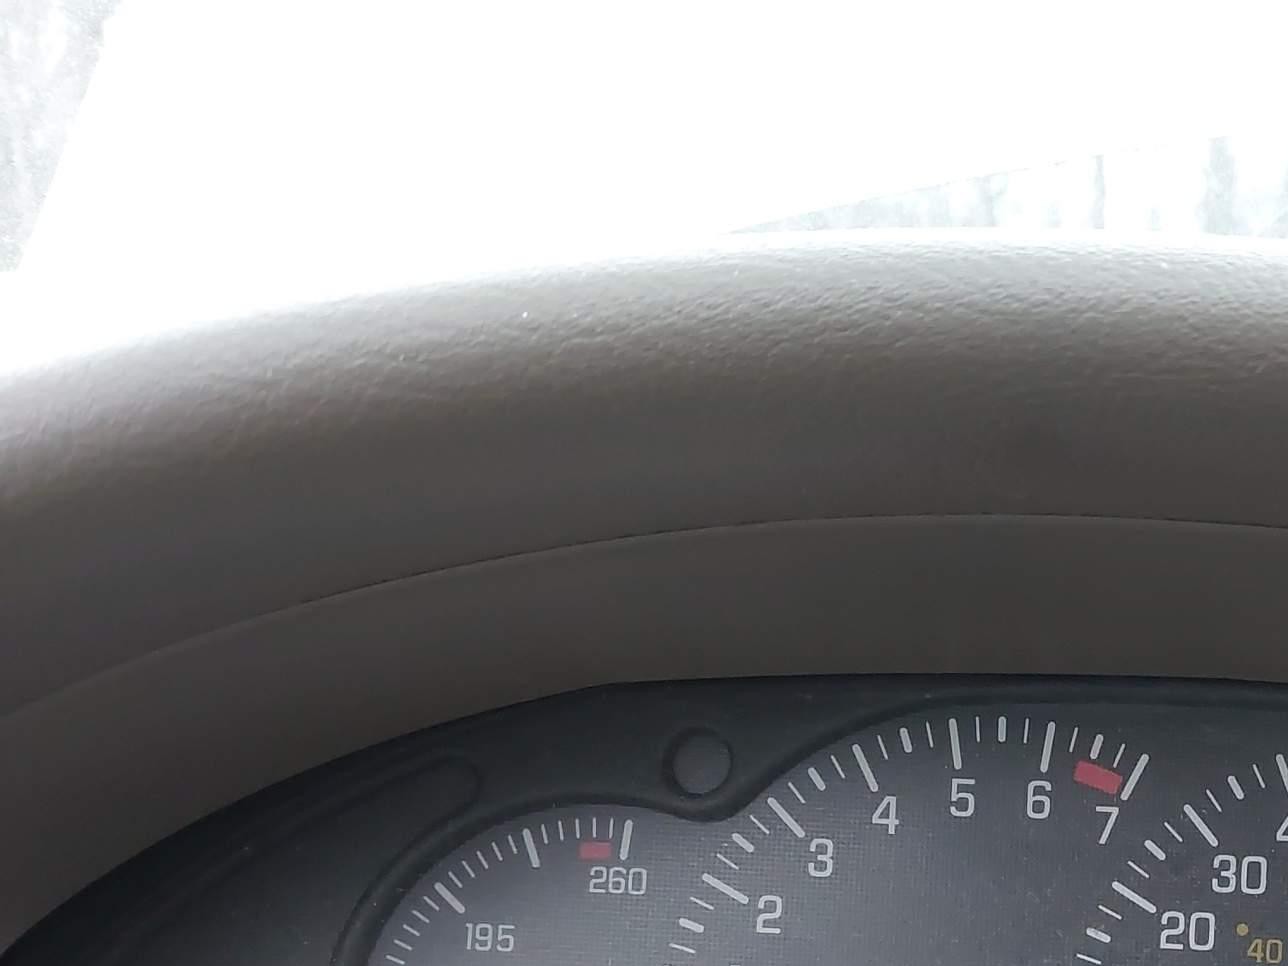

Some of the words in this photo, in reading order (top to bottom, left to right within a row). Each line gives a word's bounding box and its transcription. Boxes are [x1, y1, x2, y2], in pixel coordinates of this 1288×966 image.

[872, 796, 899, 834] 4
[951, 778, 975, 817] 5
[1027, 780, 1051, 819] 6
[1095, 806, 1119, 844] 7
[808, 839, 833, 877] 3
[1211, 855, 1267, 894] 30
[588, 867, 647, 895] 260
[756, 896, 782, 934] 2
[1160, 912, 1215, 950] 20
[465, 923, 515, 952] 195
[1247, 940, 1282, 963] 40
